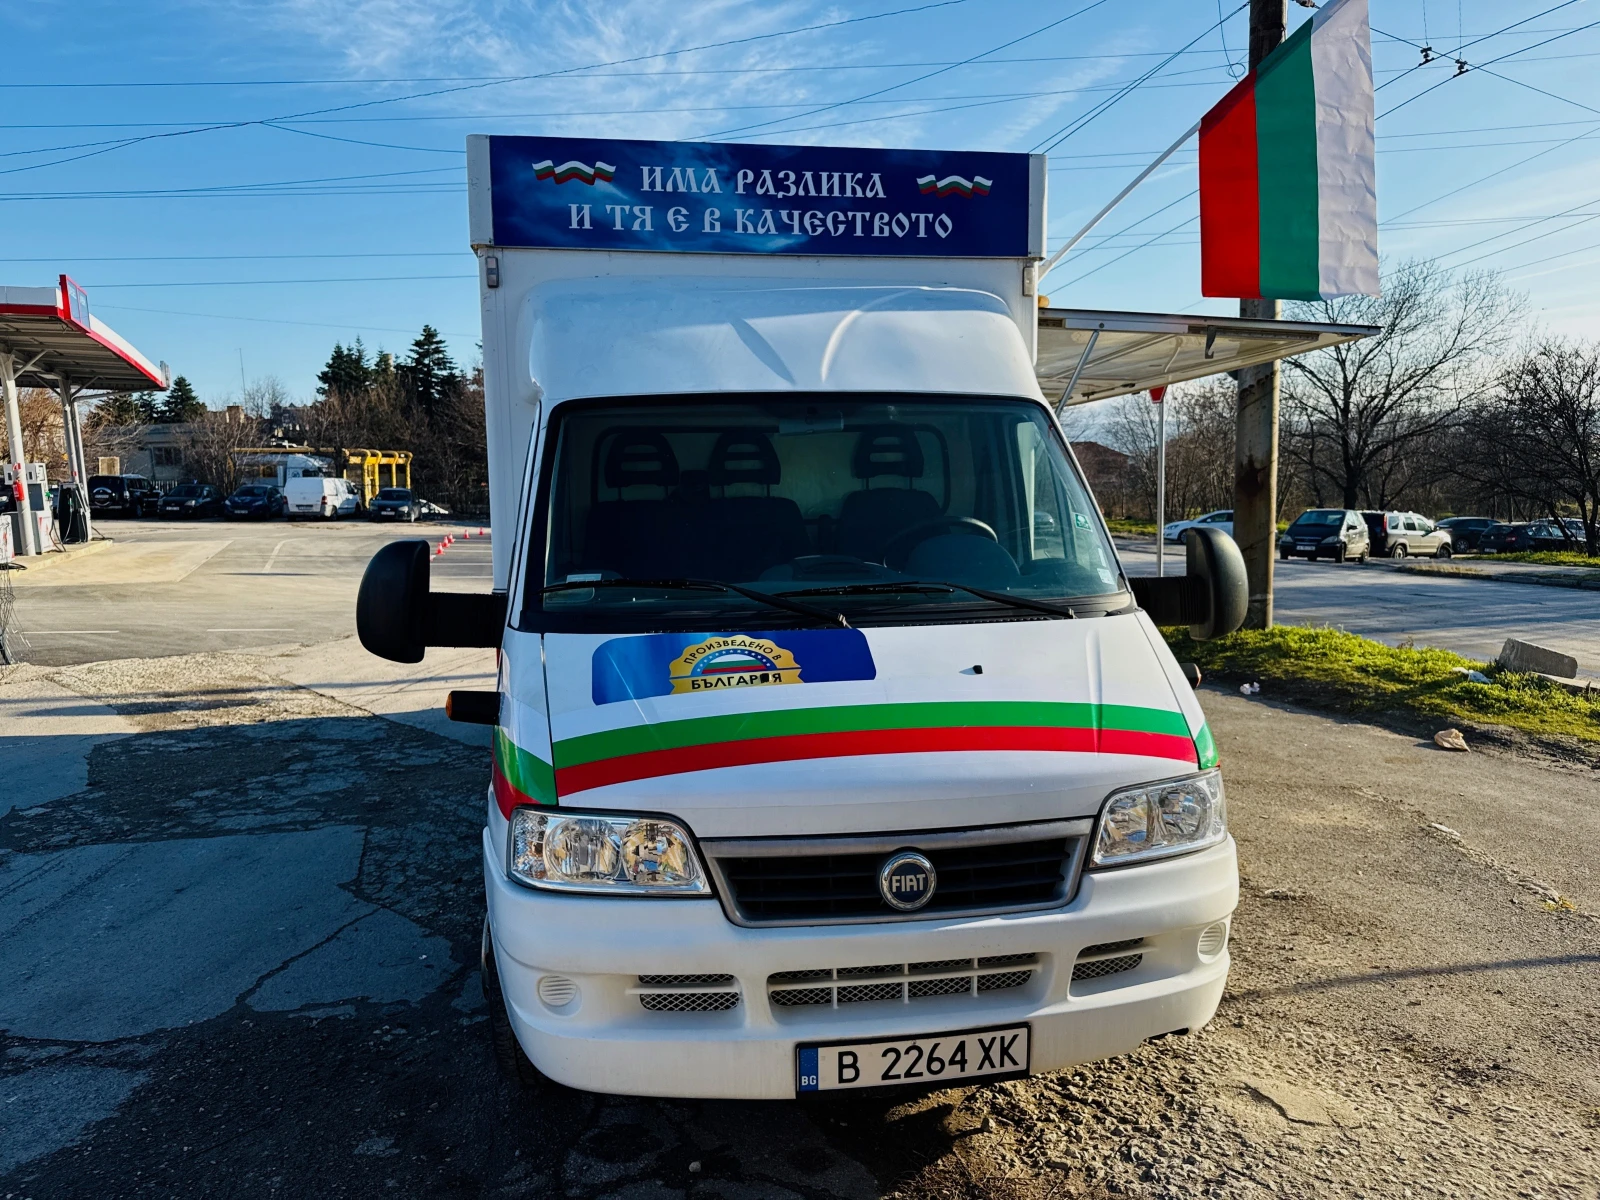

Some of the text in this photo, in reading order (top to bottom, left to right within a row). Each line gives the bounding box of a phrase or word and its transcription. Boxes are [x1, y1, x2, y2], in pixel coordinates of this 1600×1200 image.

[640, 166, 887, 199] ИМА РАЗЛИКА
[568, 204, 593, 230] И
[605, 204, 653, 231] ТЯ
[702, 208, 721, 233] В
[683, 640, 782, 664] ПРОИЗВЕДЕНО В
[691, 673, 782, 690] БЪЛГАРЯ
[892, 874, 925, 892] FIAT
[881, 1040, 968, 1081] 2264
[801, 1075, 817, 1086] BG
